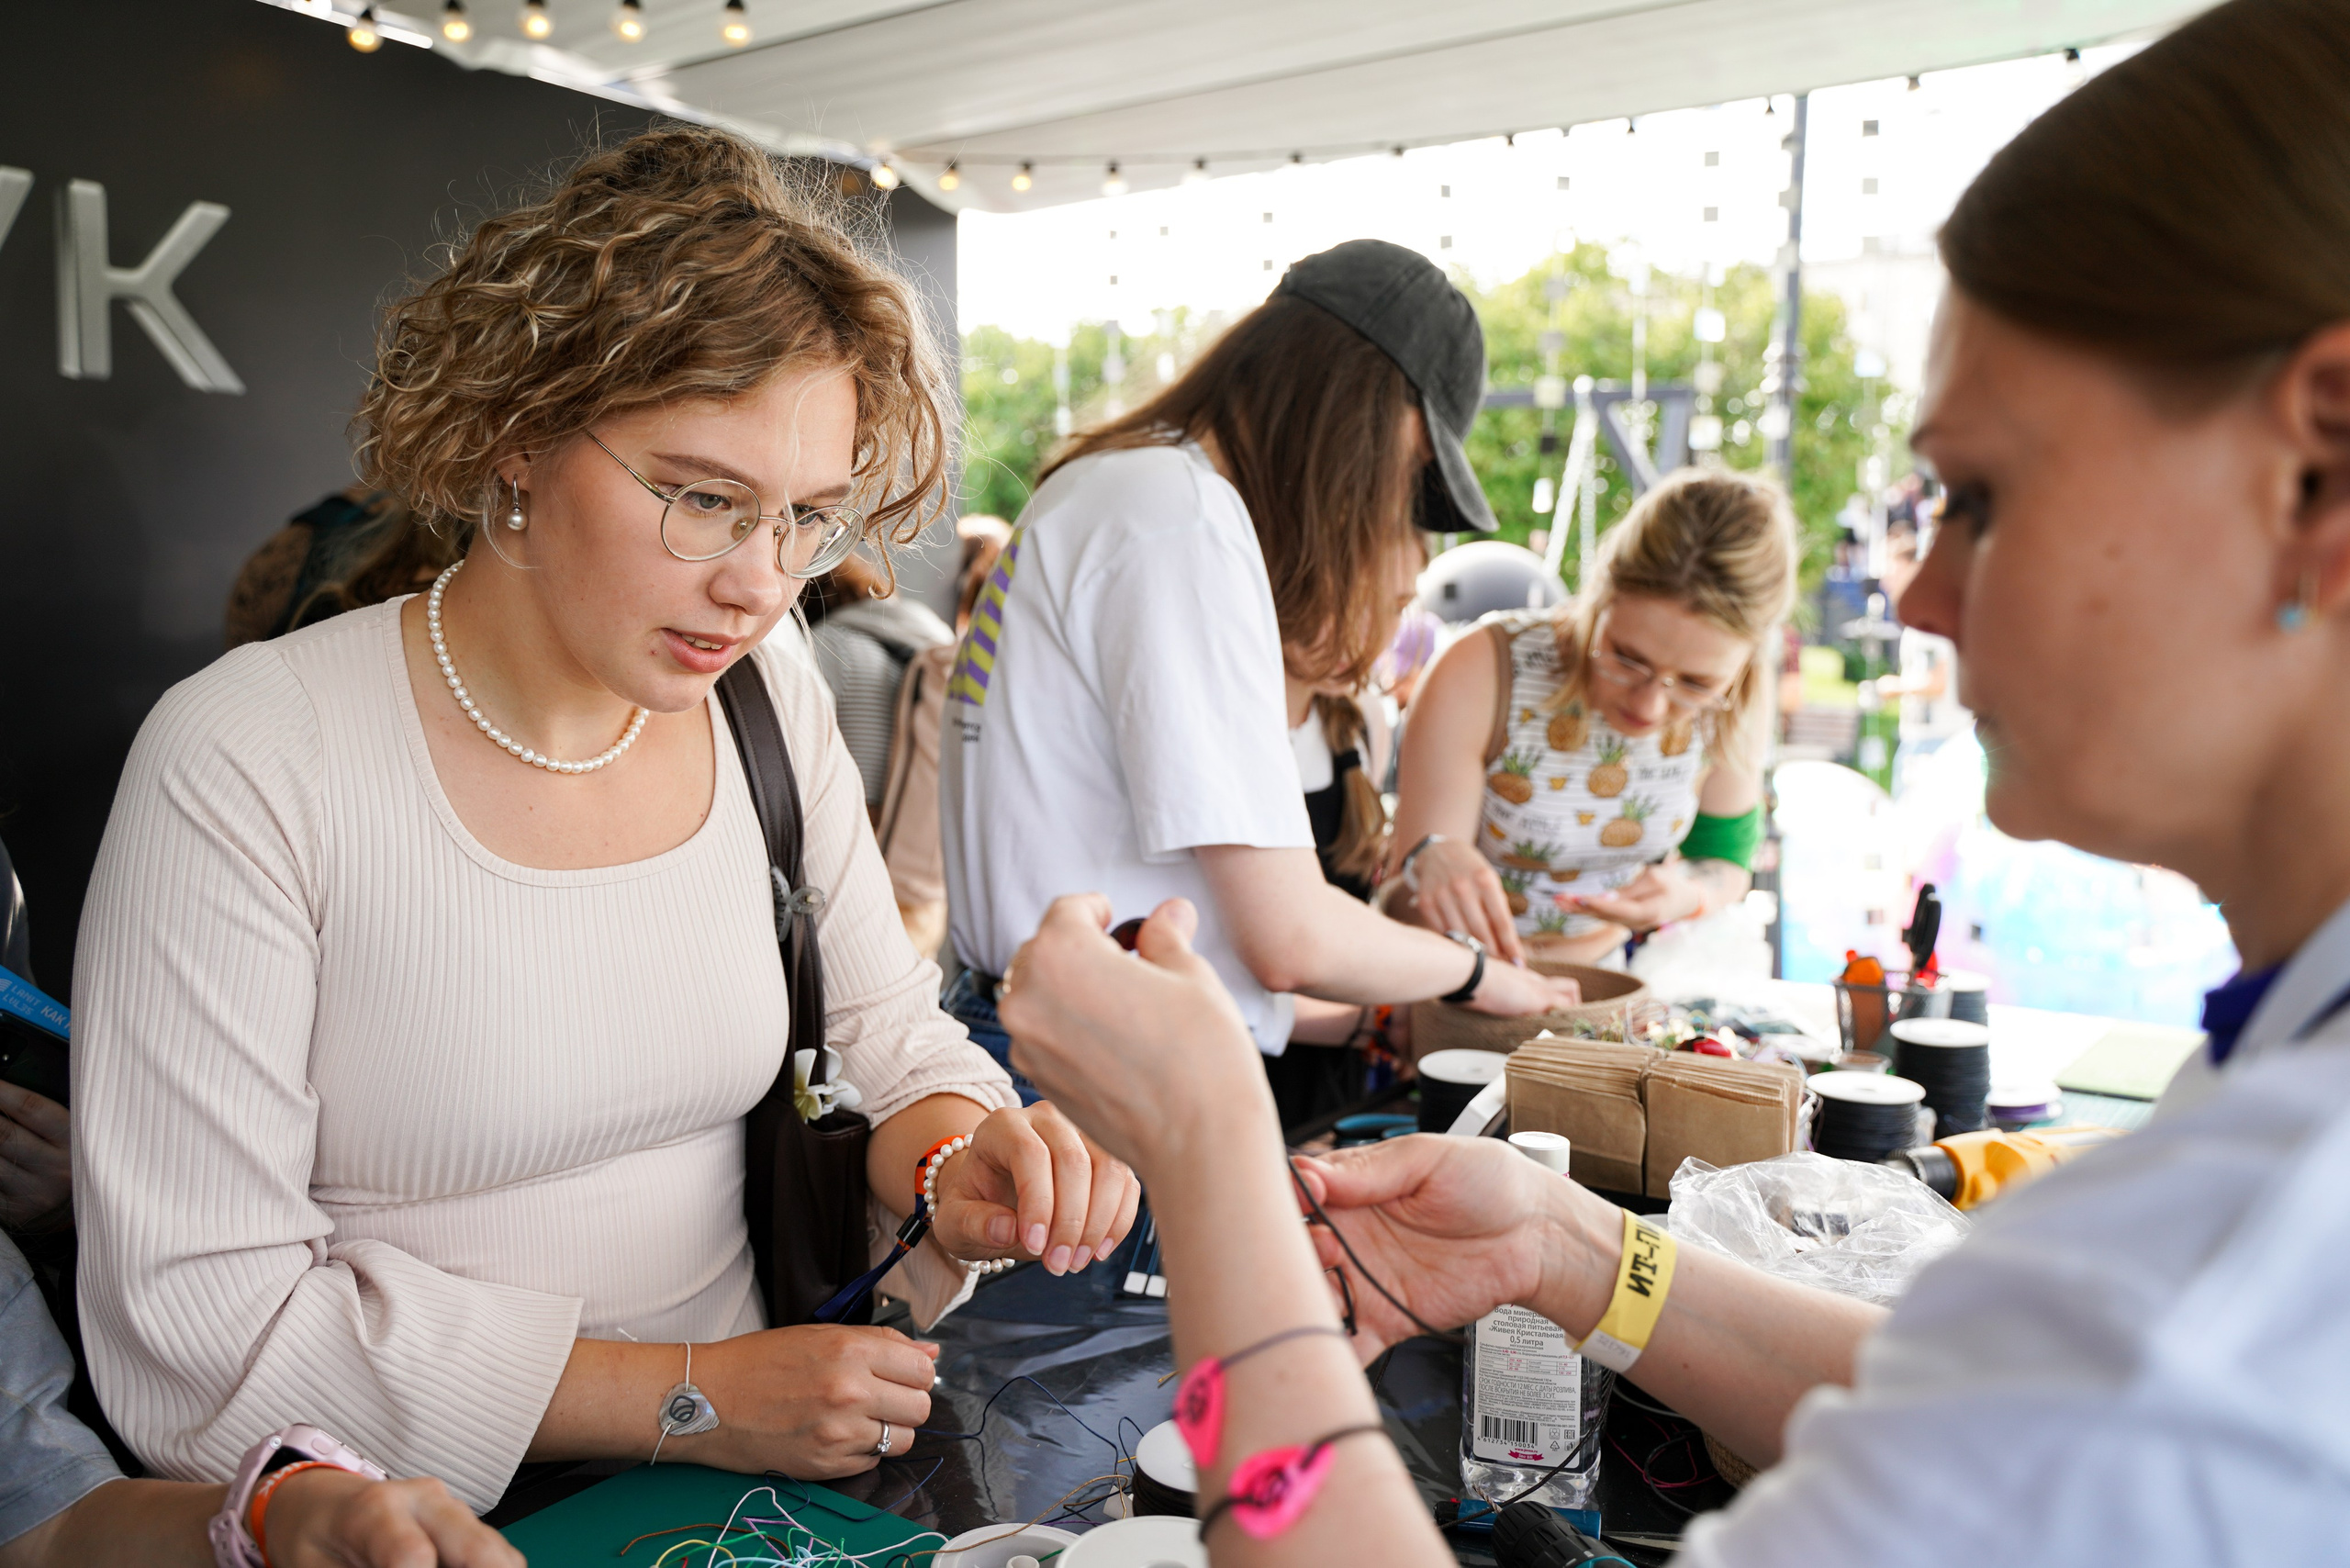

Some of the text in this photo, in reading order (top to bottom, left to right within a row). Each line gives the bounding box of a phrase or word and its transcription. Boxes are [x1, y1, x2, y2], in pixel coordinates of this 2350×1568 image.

[1493, 1319, 1562, 1332] столовая питьевая
[1507, 1316, 1549, 1325] природная
[1510, 1336, 1521, 1344] 0,5
[1478, 1377, 1491, 1385] СРОК
[1491, 1379, 1516, 1389] ГОДНОСТИ
[1539, 1384, 1552, 1393] ДАТЫ
[1478, 1383, 1494, 1392] ПОСЛЕ
[1494, 1385, 1519, 1394] ВСКРЫТИЯ
[1527, 1390, 1541, 1398] БОЛЕЕ
